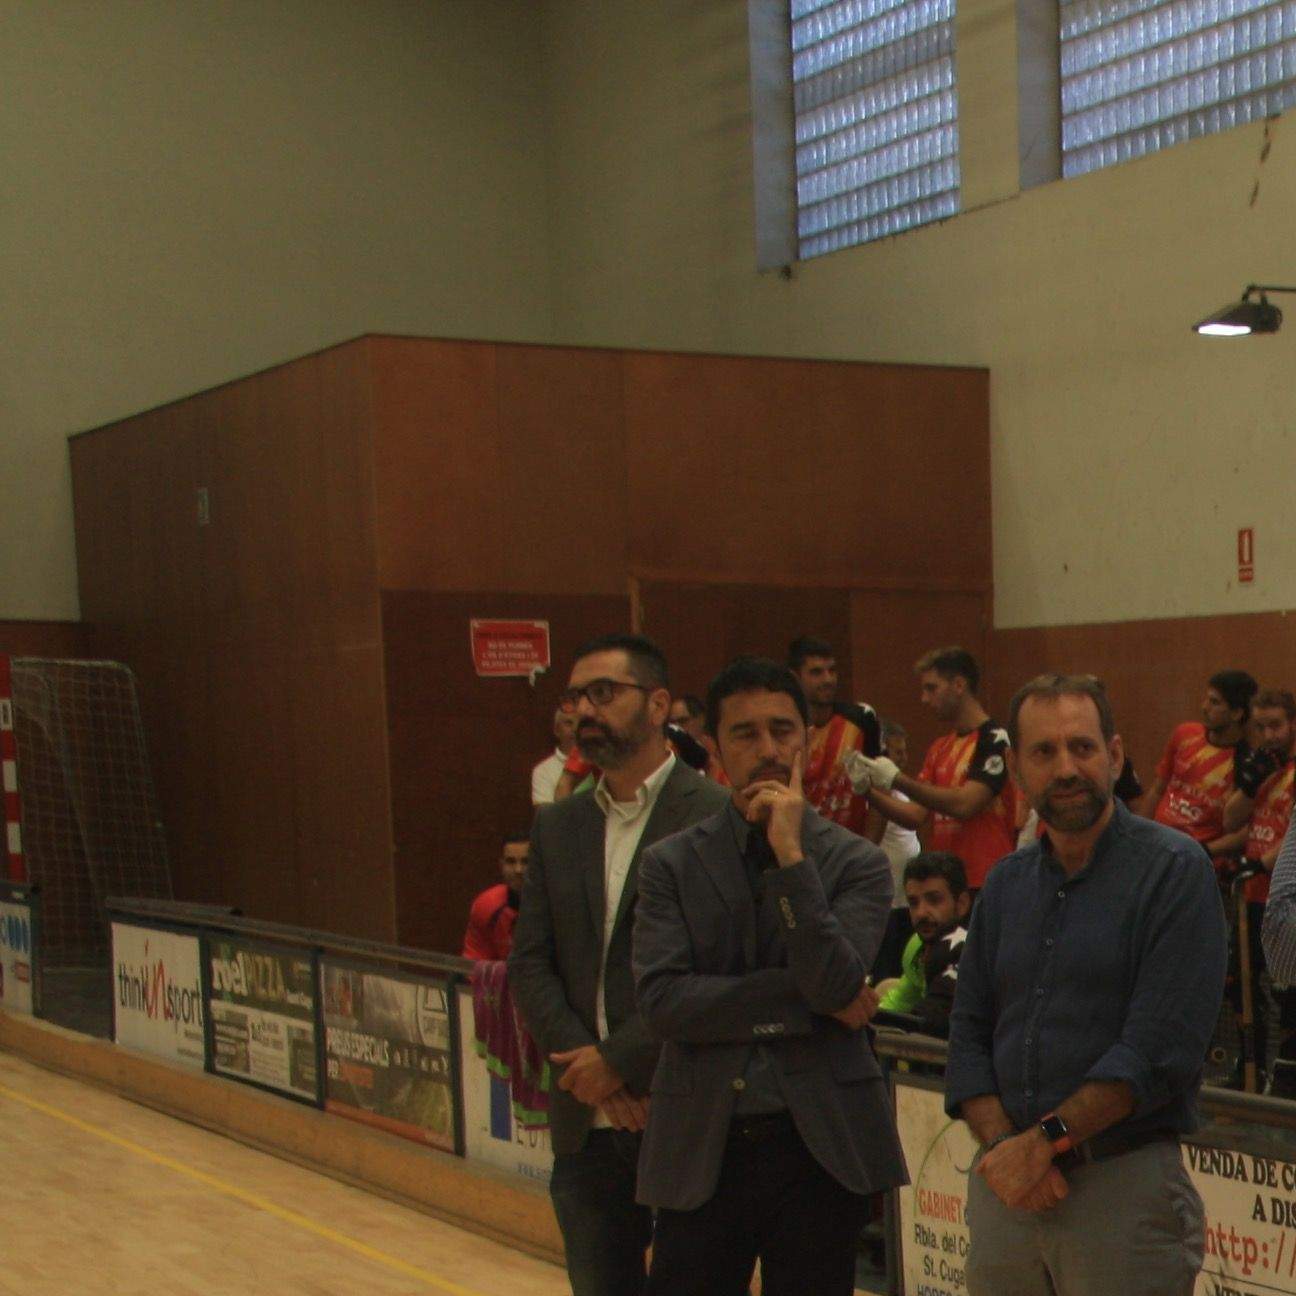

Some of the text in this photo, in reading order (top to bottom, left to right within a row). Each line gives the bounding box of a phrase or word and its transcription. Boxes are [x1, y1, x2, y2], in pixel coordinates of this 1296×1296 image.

[1186, 1144, 1248, 1184] VENDA
[1252, 1155, 1278, 1188] DE
[918, 1187, 964, 1226] GABINET
[1252, 1193, 1267, 1223] A
[941, 1230, 957, 1256] del
